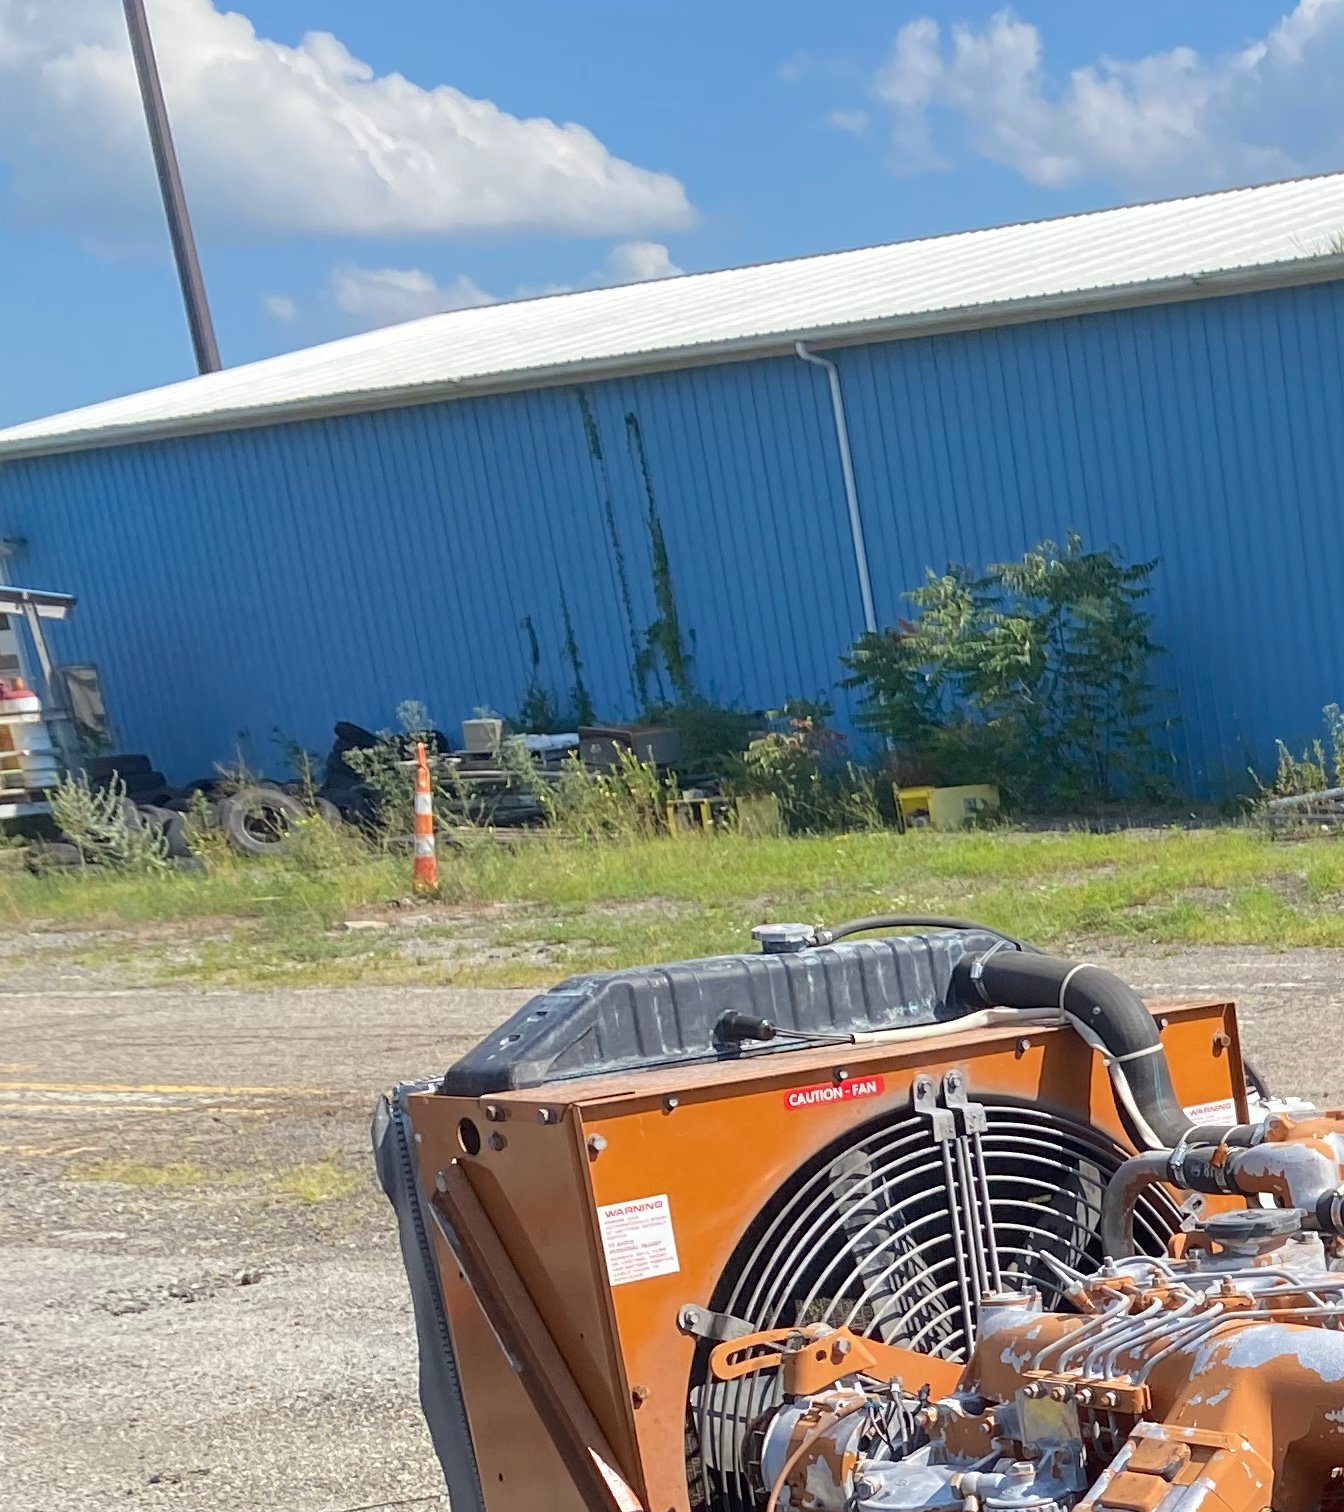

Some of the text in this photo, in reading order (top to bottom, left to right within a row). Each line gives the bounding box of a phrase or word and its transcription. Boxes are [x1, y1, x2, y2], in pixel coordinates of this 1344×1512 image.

[789, 1087, 843, 1106] CAUTION
[852, 1081, 877, 1096] FAN
[604, 1201, 663, 1217] WARNING
